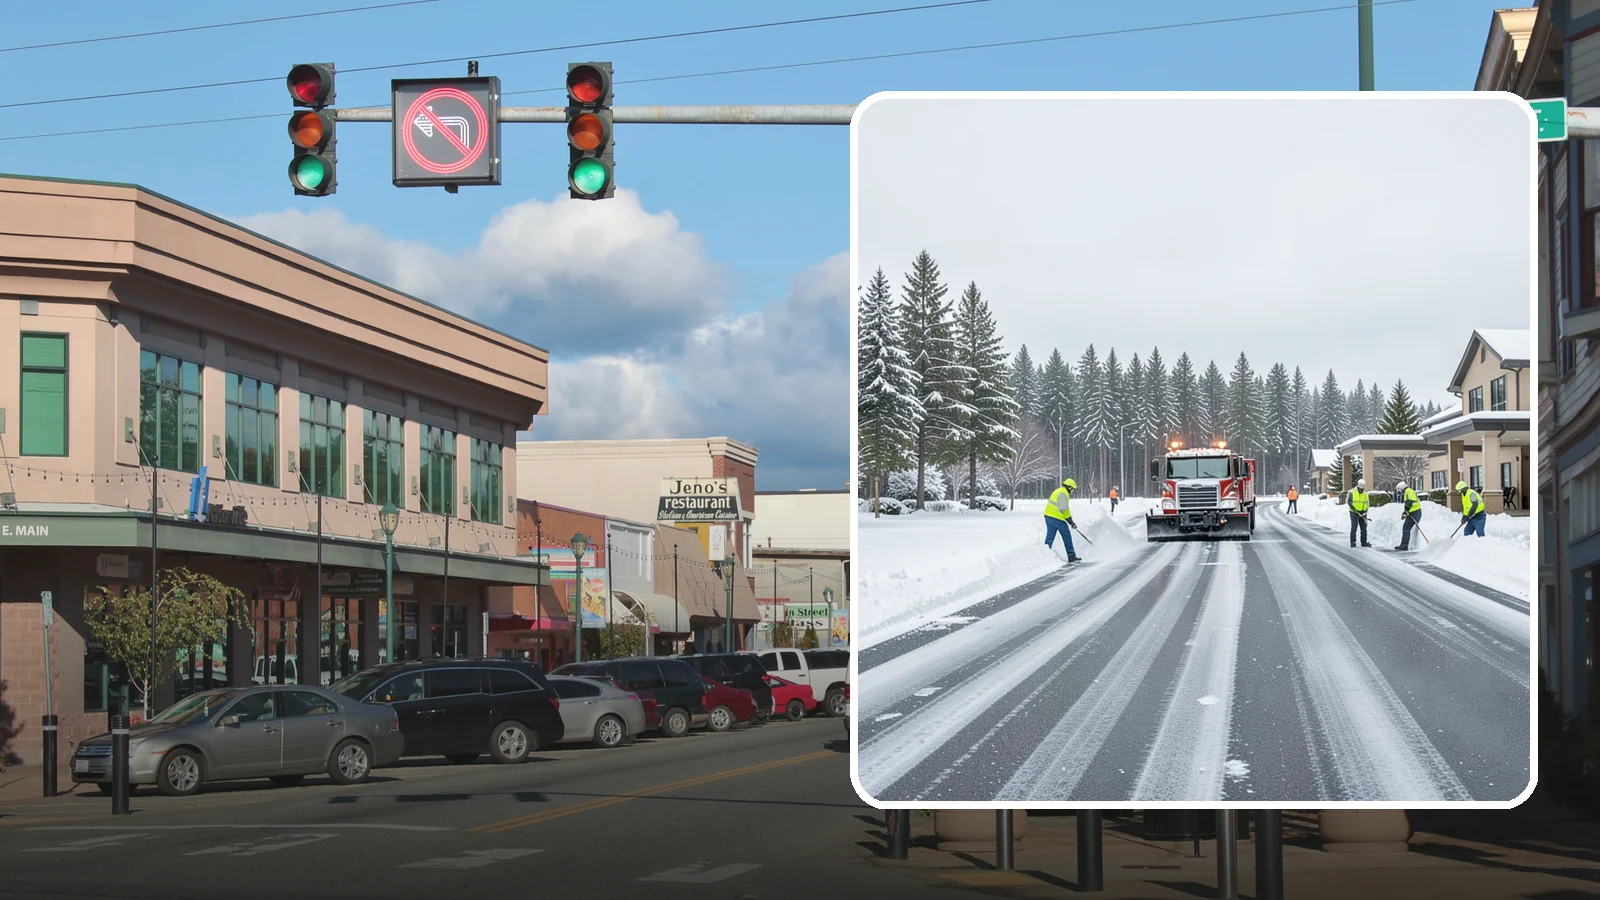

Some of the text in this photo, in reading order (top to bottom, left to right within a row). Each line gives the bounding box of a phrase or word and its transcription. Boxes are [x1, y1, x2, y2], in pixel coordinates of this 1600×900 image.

[669, 480, 728, 494] Jeno's
[665, 496, 731, 509] restaurant
[659, 510, 681, 519] Italian
[686, 510, 714, 519] American
[715, 509, 737, 519] Cuisine
[2, 525, 49, 536] E. MAIN
[797, 607, 828, 616] Street
[791, 619, 824, 627] lass
